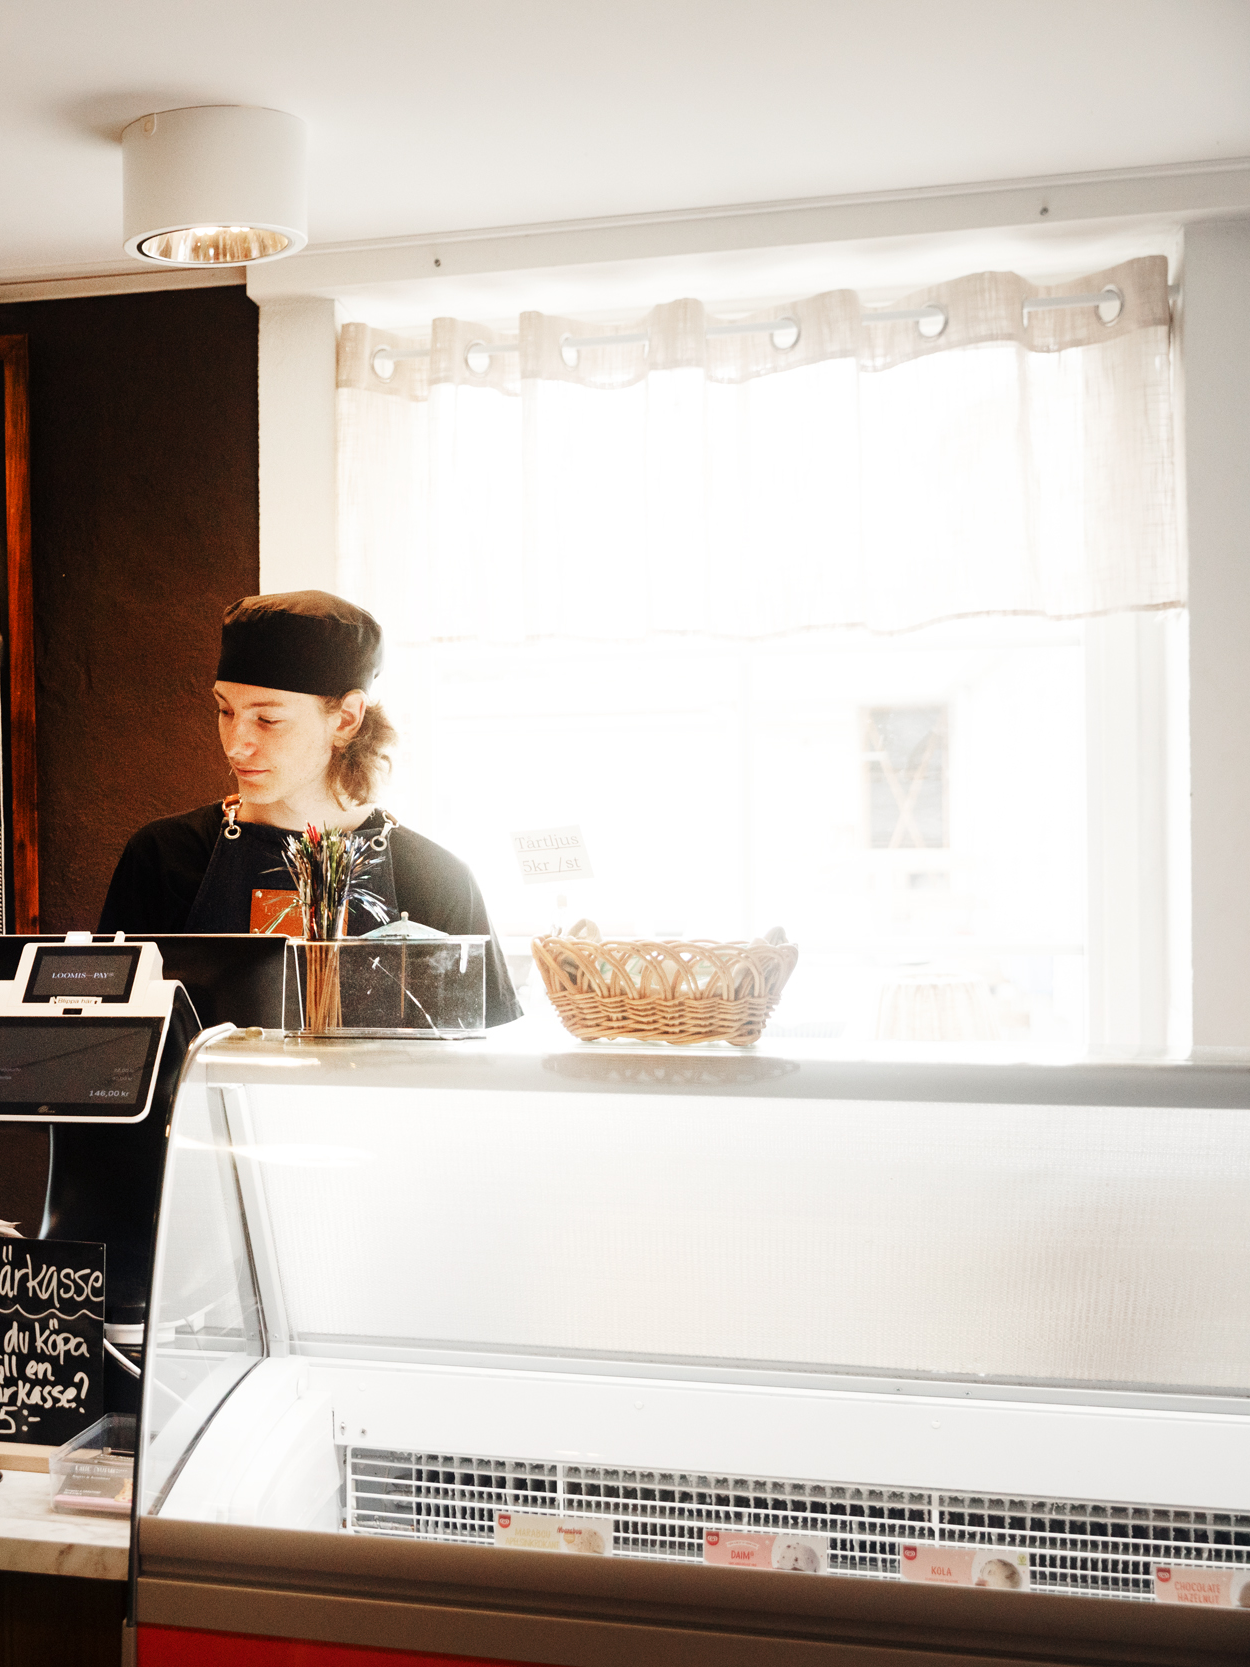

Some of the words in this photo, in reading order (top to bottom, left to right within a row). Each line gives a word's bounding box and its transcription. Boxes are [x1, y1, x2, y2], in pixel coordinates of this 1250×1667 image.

[514, 834, 580, 850] Tårtljus
[522, 859, 550, 873] 5kr
[4, 1321, 29, 1354] du
[25, 1360, 55, 1381] en
[515, 1527, 551, 1539] MARABOU
[931, 1566, 952, 1577] KOLA
[1175, 1581, 1221, 1594] CHOCOLATE
[1177, 1592, 1220, 1605] HAZELNUT
